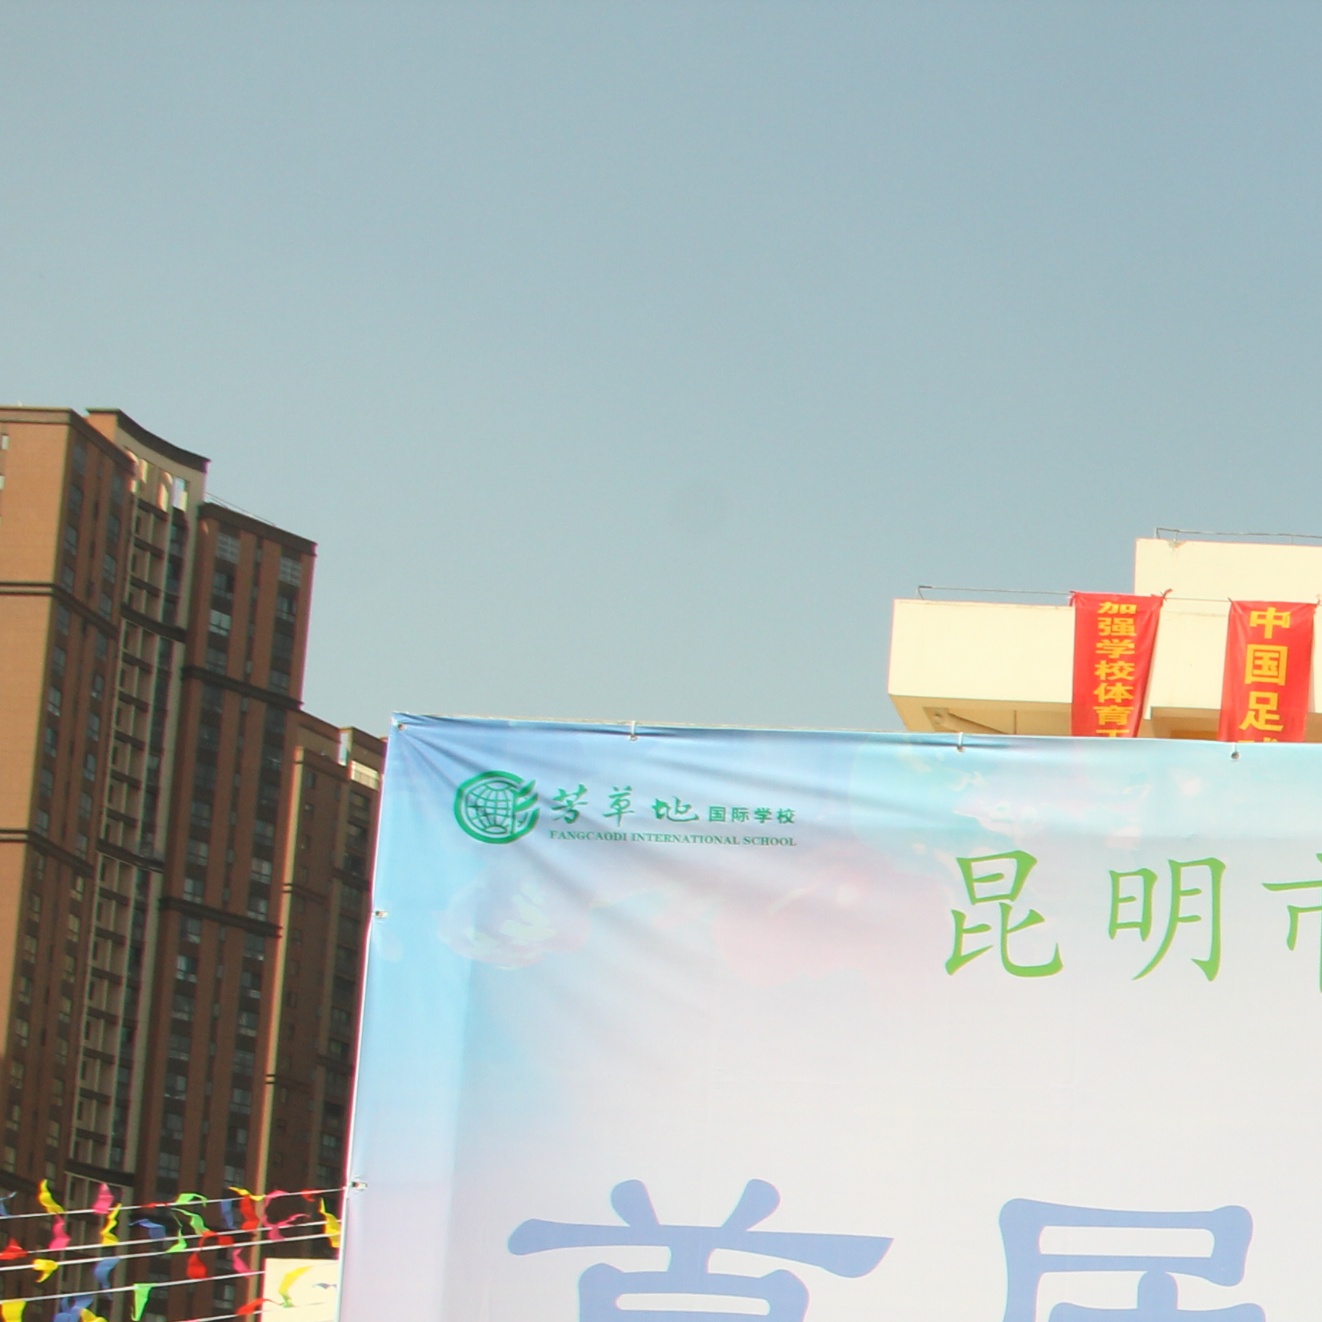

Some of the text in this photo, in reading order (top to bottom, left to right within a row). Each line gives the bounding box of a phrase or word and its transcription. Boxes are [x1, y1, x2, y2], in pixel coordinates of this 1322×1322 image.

[1237, 607, 1291, 742] 中国足
[550, 830, 797, 846] FANGCAODI INTERNATIONAL SCHOOL
